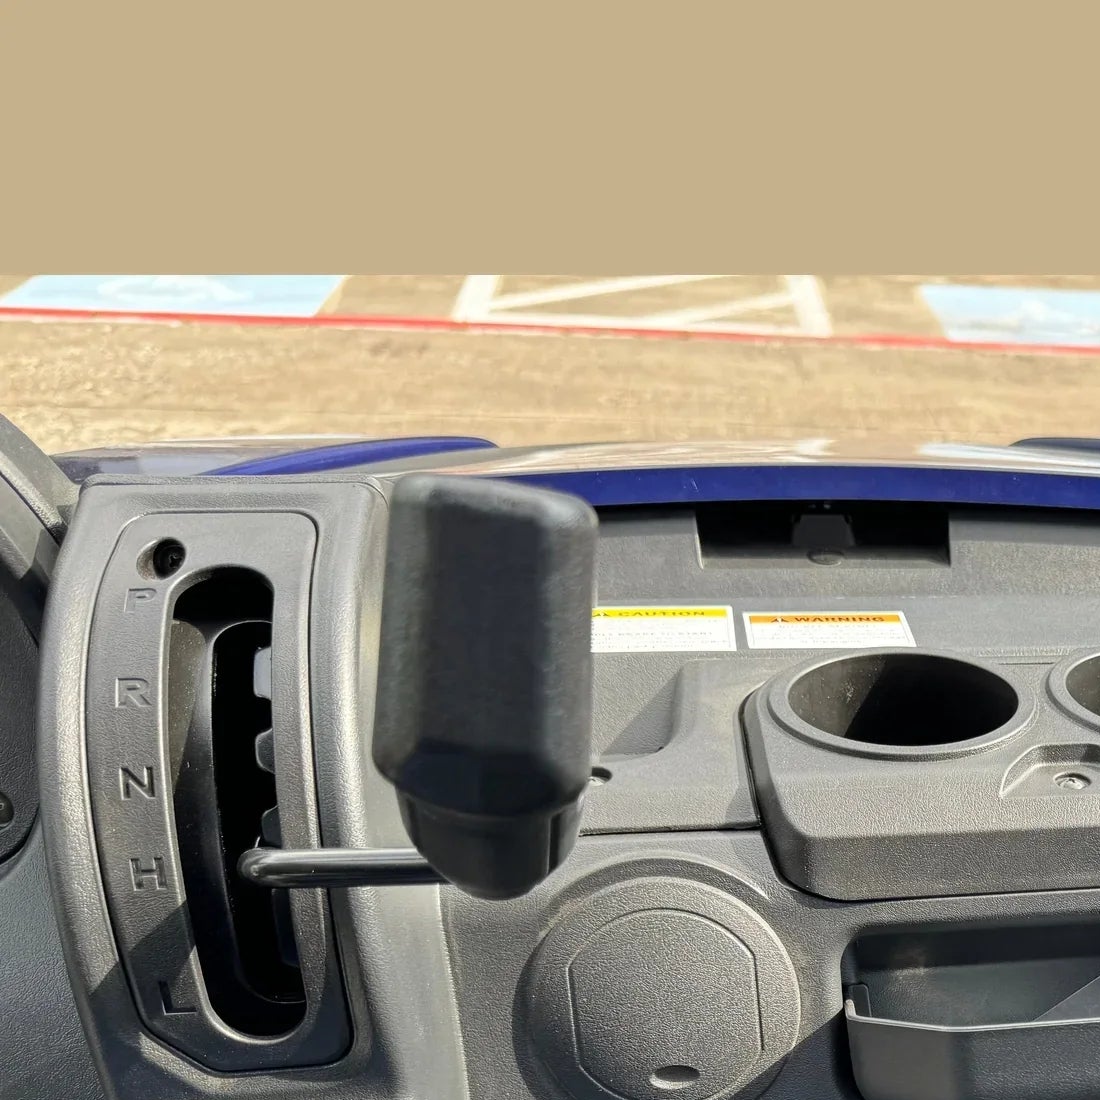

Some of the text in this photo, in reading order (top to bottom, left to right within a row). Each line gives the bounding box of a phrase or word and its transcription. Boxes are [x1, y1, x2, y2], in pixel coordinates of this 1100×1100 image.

[123, 586, 158, 614] P
[618, 610, 705, 618] CAUTION
[793, 615, 886, 623] WARNING
[113, 677, 152, 709] R
[118, 766, 156, 801] N
[129, 856, 169, 892] H
[157, 979, 197, 1017] L
